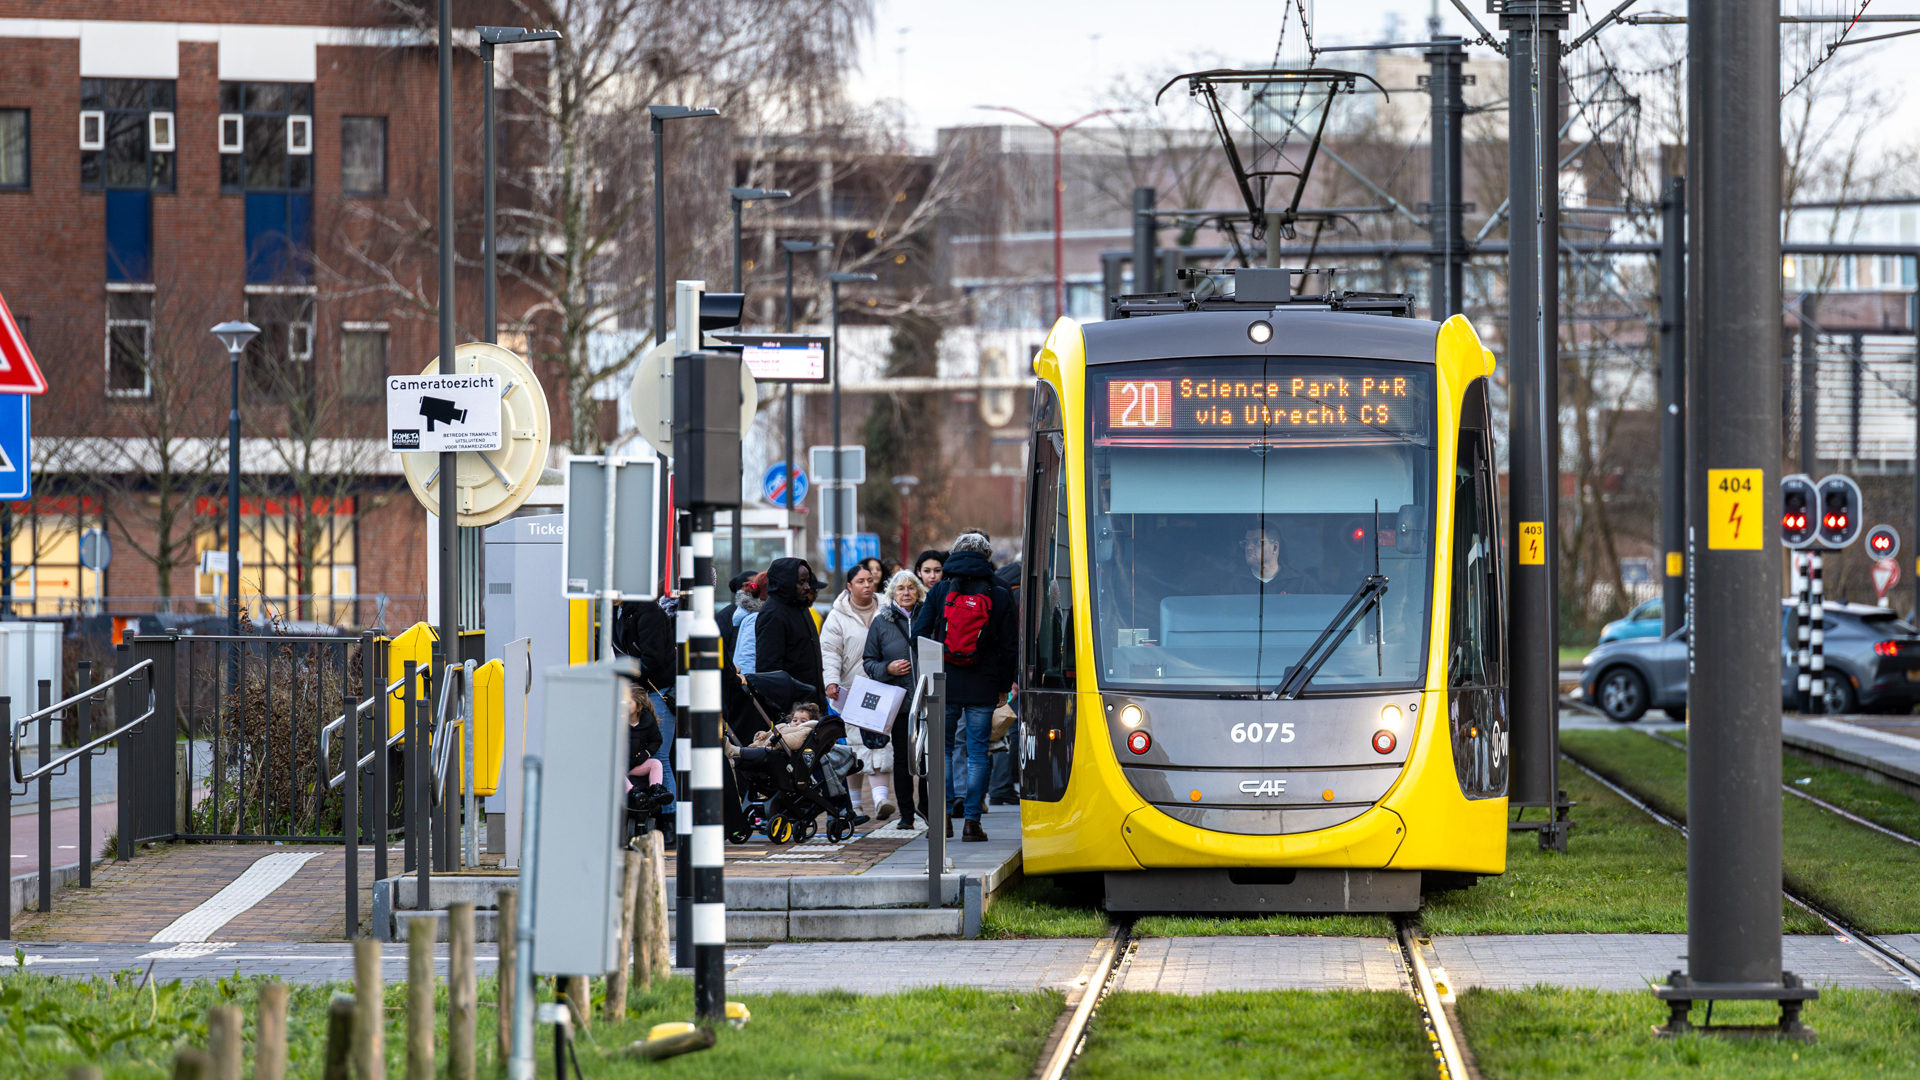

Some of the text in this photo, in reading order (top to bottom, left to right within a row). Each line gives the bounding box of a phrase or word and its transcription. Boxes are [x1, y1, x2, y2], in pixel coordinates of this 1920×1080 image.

[390, 377, 494, 390] Cameratoezicht
[1180, 377, 1407, 397] Science Park P+R
[1121, 382, 1159, 427] 20
[1195, 404, 1389, 425] via Utrecht CS
[1719, 477, 1752, 493] 404
[1524, 526, 1543, 535] 403
[1156, 667, 1162, 677] 1
[1230, 722, 1296, 743] 6075
[1238, 779, 1287, 797] CAF
